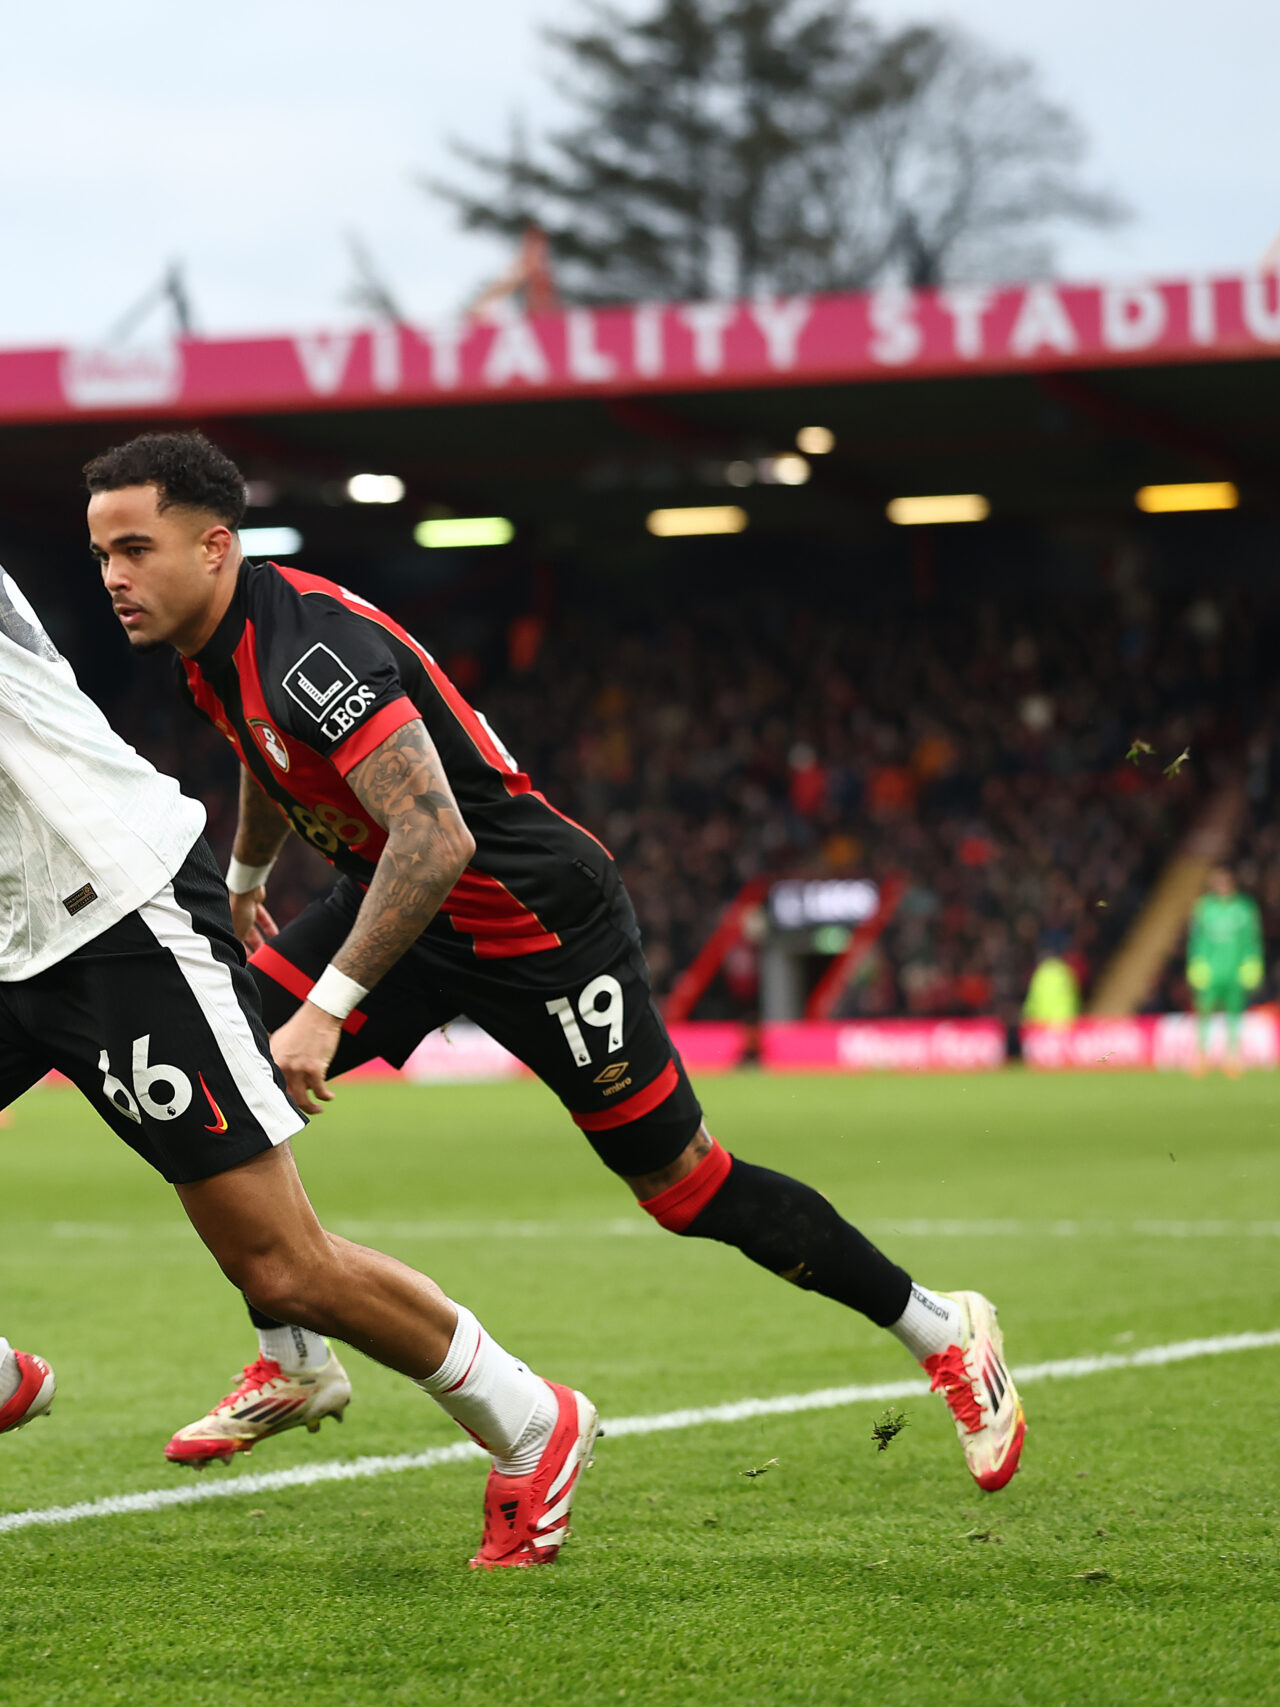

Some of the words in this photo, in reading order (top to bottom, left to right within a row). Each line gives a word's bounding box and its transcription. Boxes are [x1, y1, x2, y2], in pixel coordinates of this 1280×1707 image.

[292, 297, 813, 396] VITALITY
[320, 684, 377, 742] LEOS
[545, 974, 624, 1068] 19
[98, 1034, 193, 1125] 66
[602, 1077, 632, 1096] umbro
